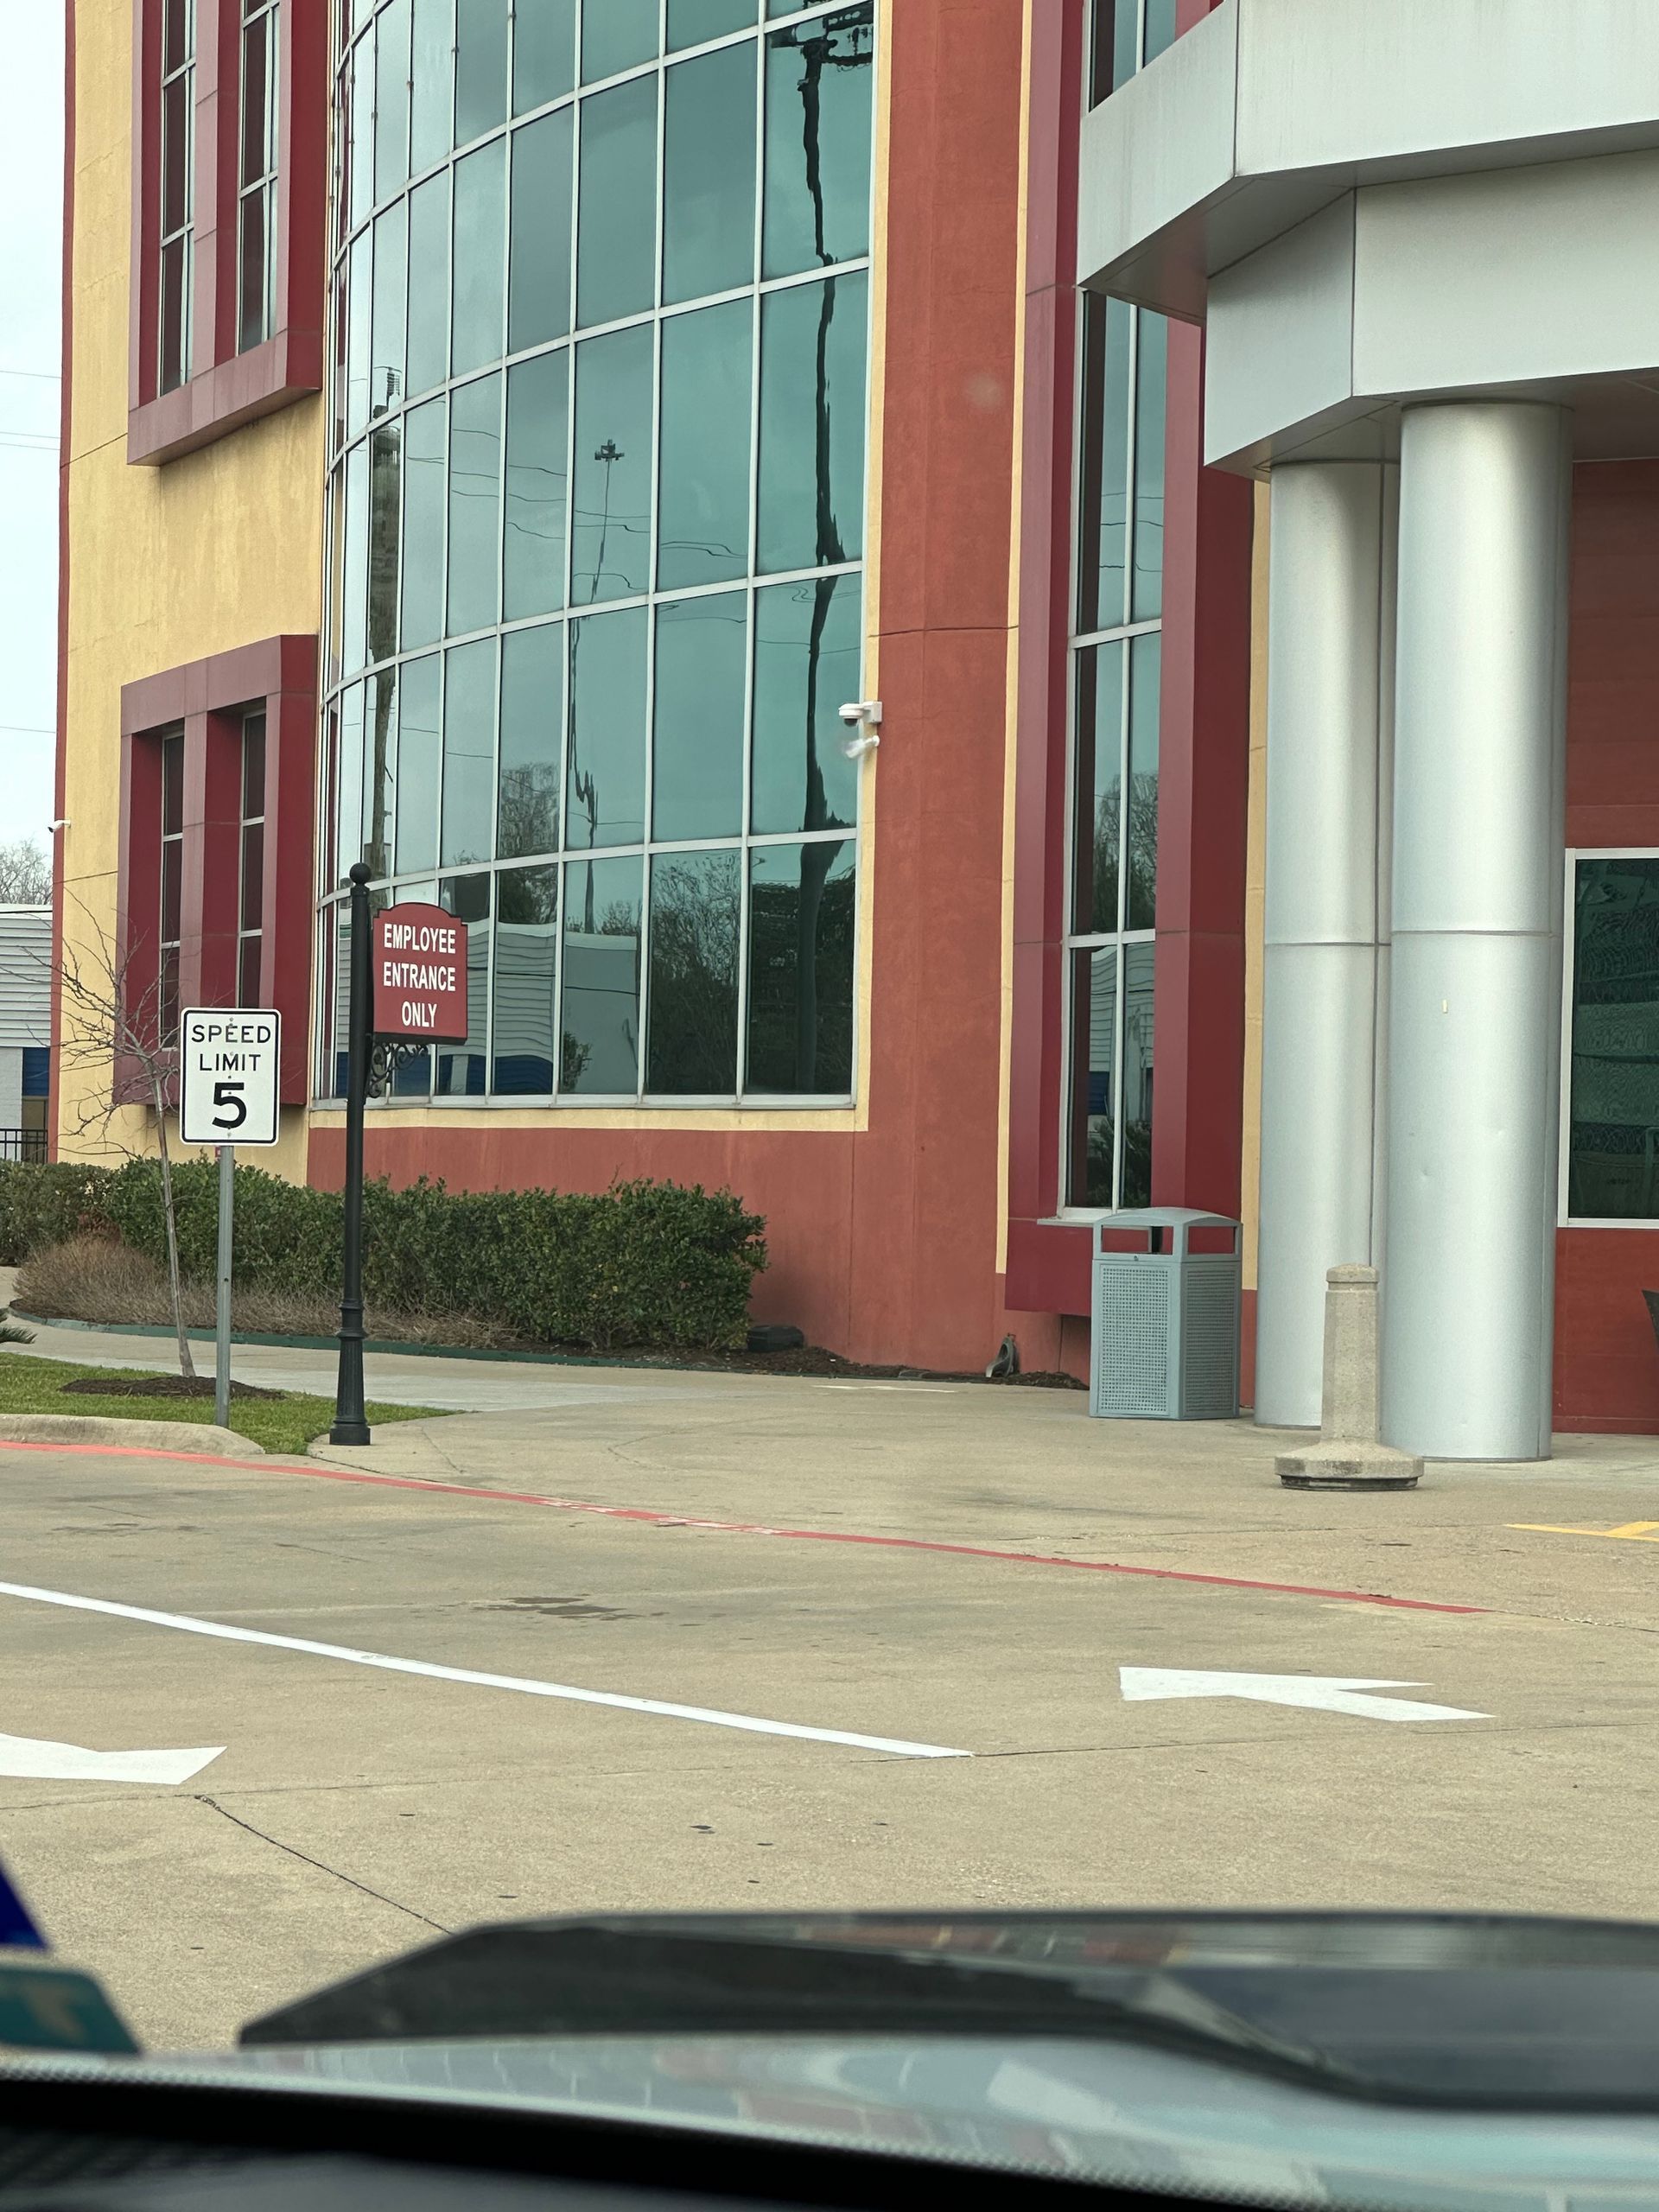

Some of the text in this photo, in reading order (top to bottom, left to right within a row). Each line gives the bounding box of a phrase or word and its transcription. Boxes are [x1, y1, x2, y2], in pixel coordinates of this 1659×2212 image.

[384, 923, 455, 954] EMPLOYEE
[383, 961, 455, 992] ENTRANCE
[401, 1001, 437, 1027] ONLY
[191, 1025, 271, 1044] SPEED
[199, 1053, 261, 1071] LIMIT
[212, 1082, 247, 1128] 5
